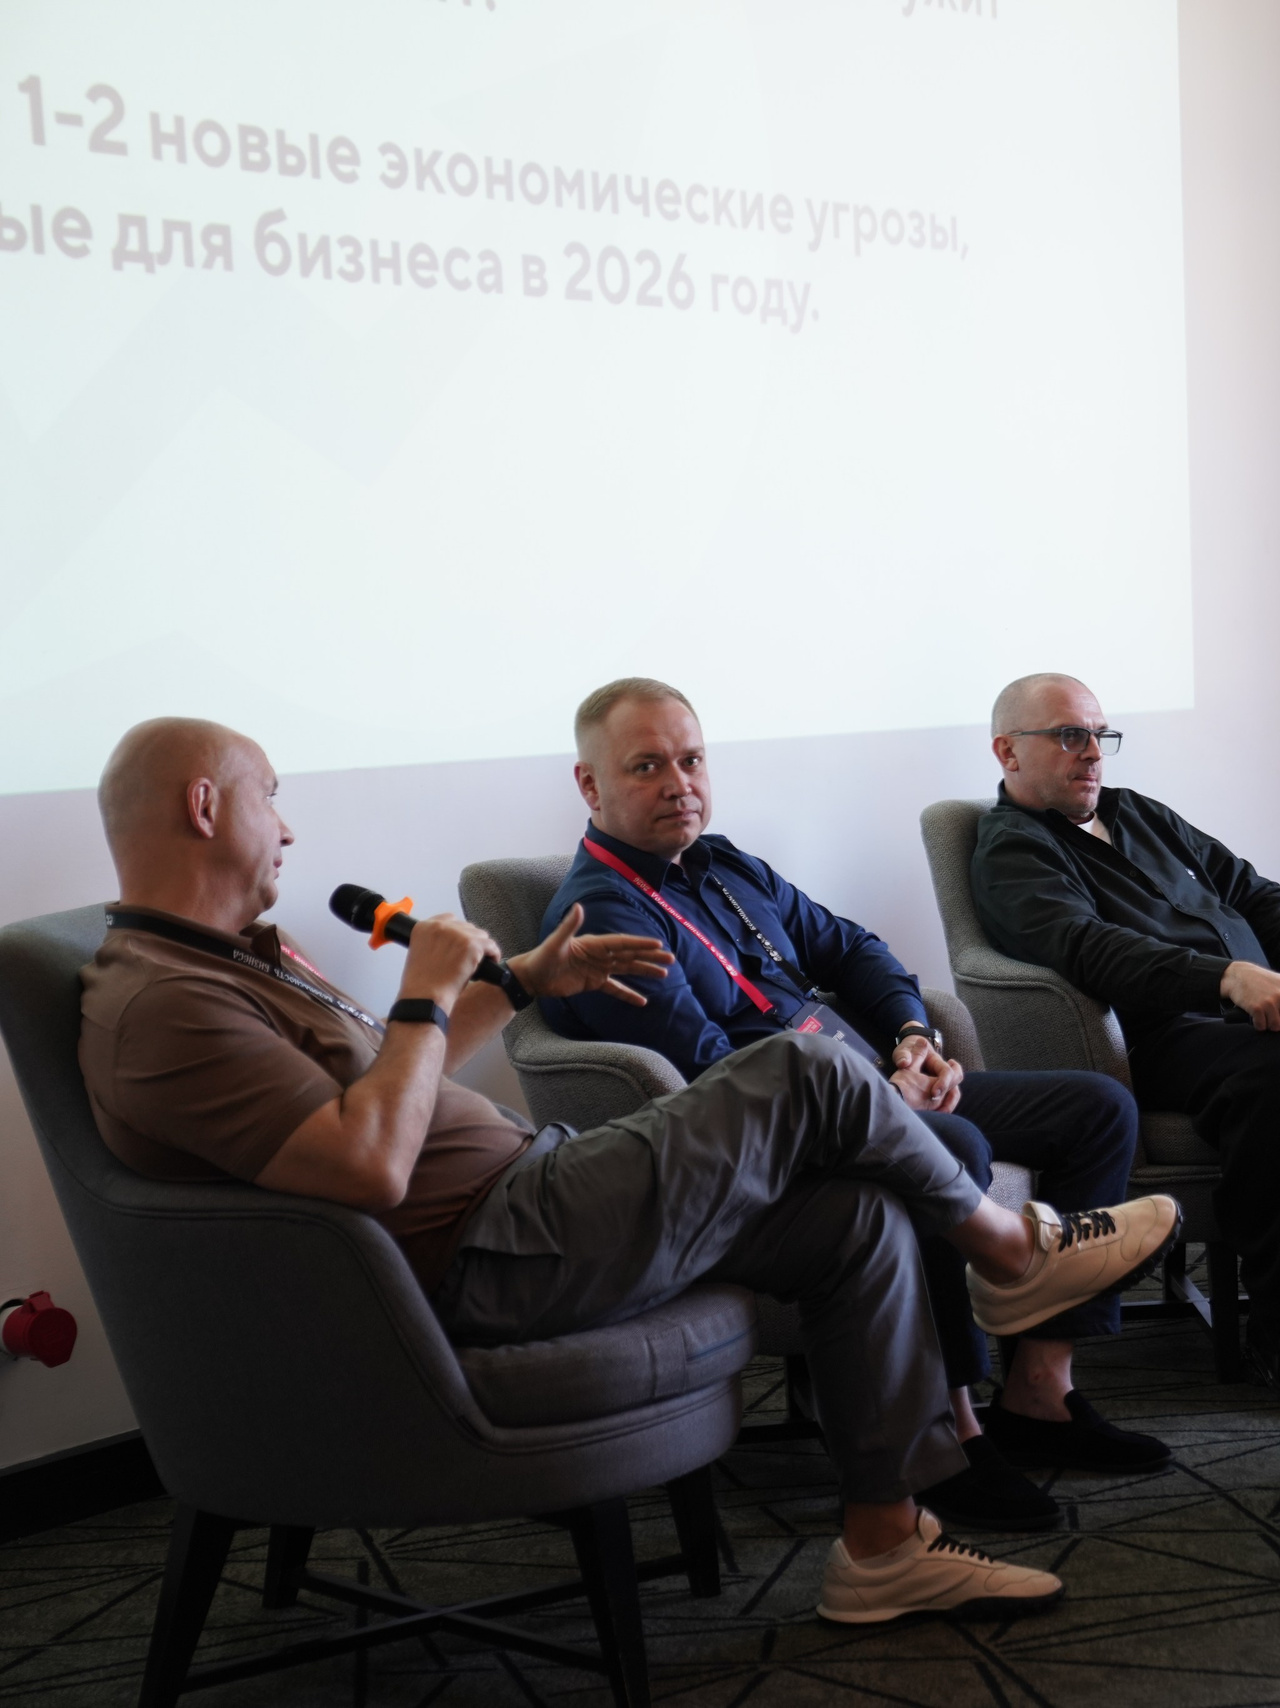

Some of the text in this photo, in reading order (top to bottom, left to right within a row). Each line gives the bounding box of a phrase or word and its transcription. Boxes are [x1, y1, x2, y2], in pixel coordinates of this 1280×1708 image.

[149, 111, 361, 184] новые
[377, 141, 794, 235] экономические
[803, 197, 969, 260] угрозы,
[111, 212, 234, 274] для
[253, 207, 503, 295] бизнеса
[521, 252, 549, 298] в
[563, 241, 696, 311] 2026
[709, 272, 820, 334] году.
[232, 949, 270, 973] БИЗНЕСА
